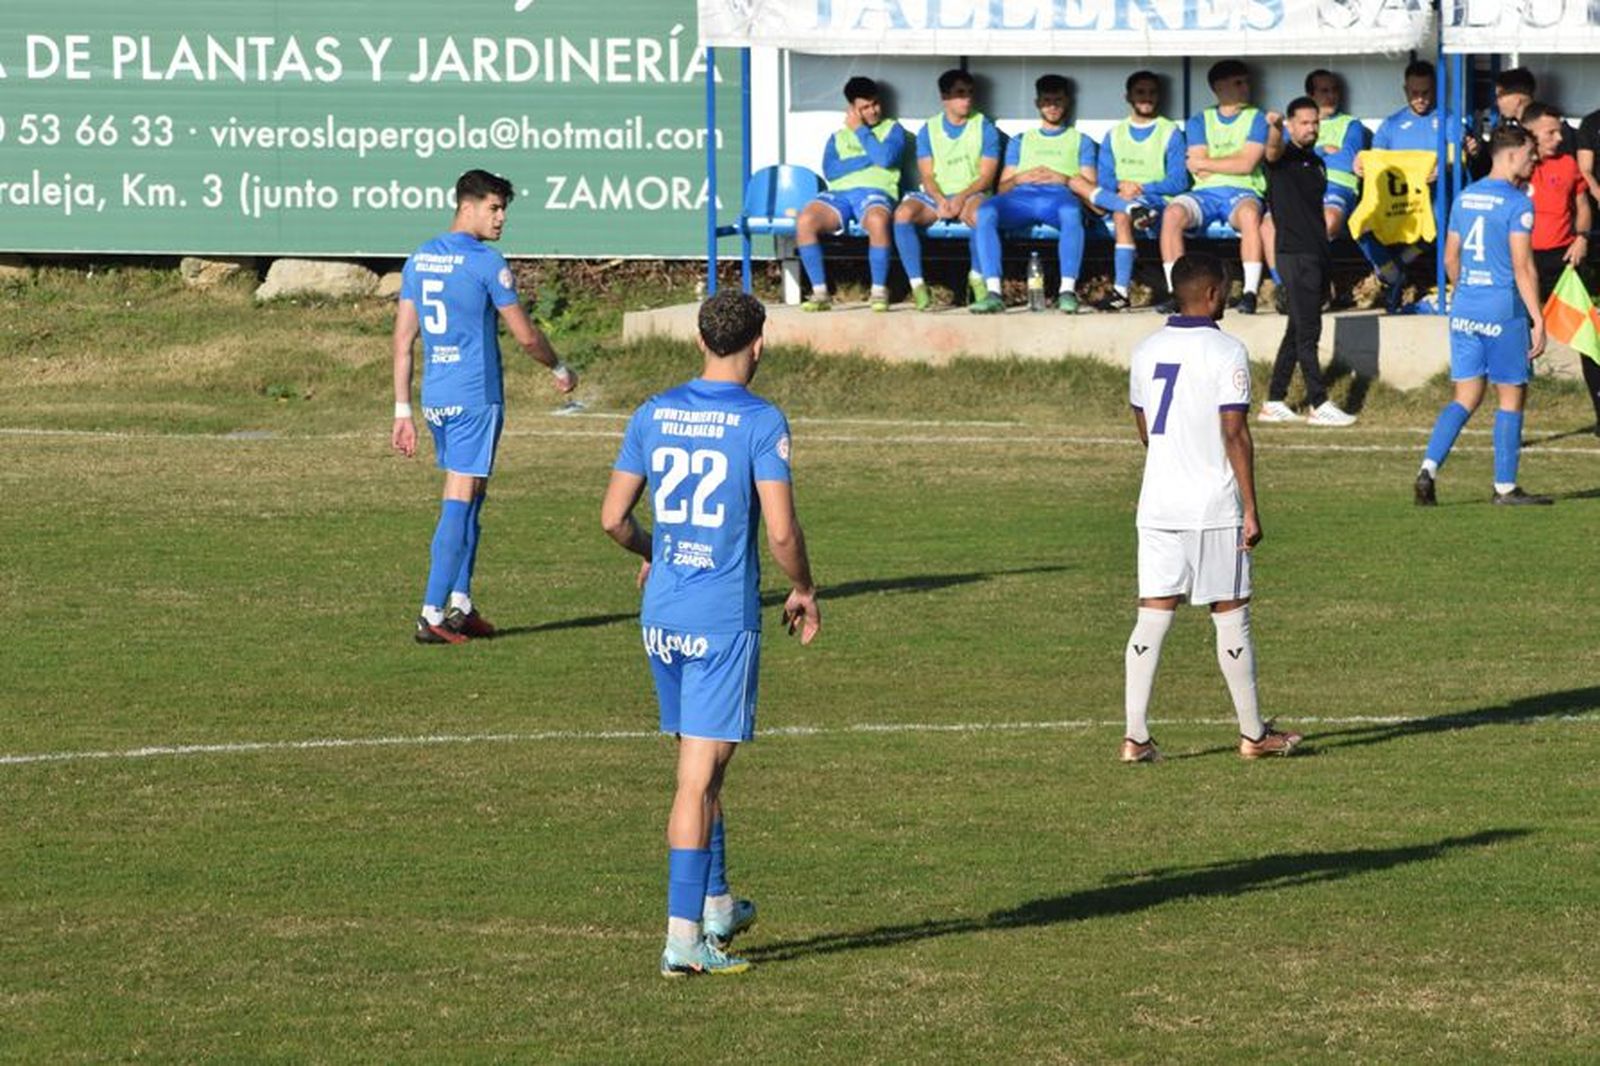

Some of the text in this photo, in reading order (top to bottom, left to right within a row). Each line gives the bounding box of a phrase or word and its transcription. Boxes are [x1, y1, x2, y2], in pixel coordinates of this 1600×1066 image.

[26, 34, 91, 79] DE
[112, 34, 343, 82] PLANTAS
[359, 36, 393, 82] Y
[407, 23, 723, 84] JARDINERÍA
[18, 114, 60, 146] 53
[75, 114, 119, 146] 66
[131, 115, 174, 147] 33
[210, 114, 724, 158] viveroslapergola@hotmail.com
[122, 173, 187, 207] Km.
[202, 174, 223, 208] 3
[240, 172, 339, 218] (junto
[544, 176, 724, 210] ZAMORA
[1463, 215, 1486, 262] 4
[422, 279, 448, 335] 5
[1150, 362, 1182, 435] 7
[652, 446, 729, 529] 22
